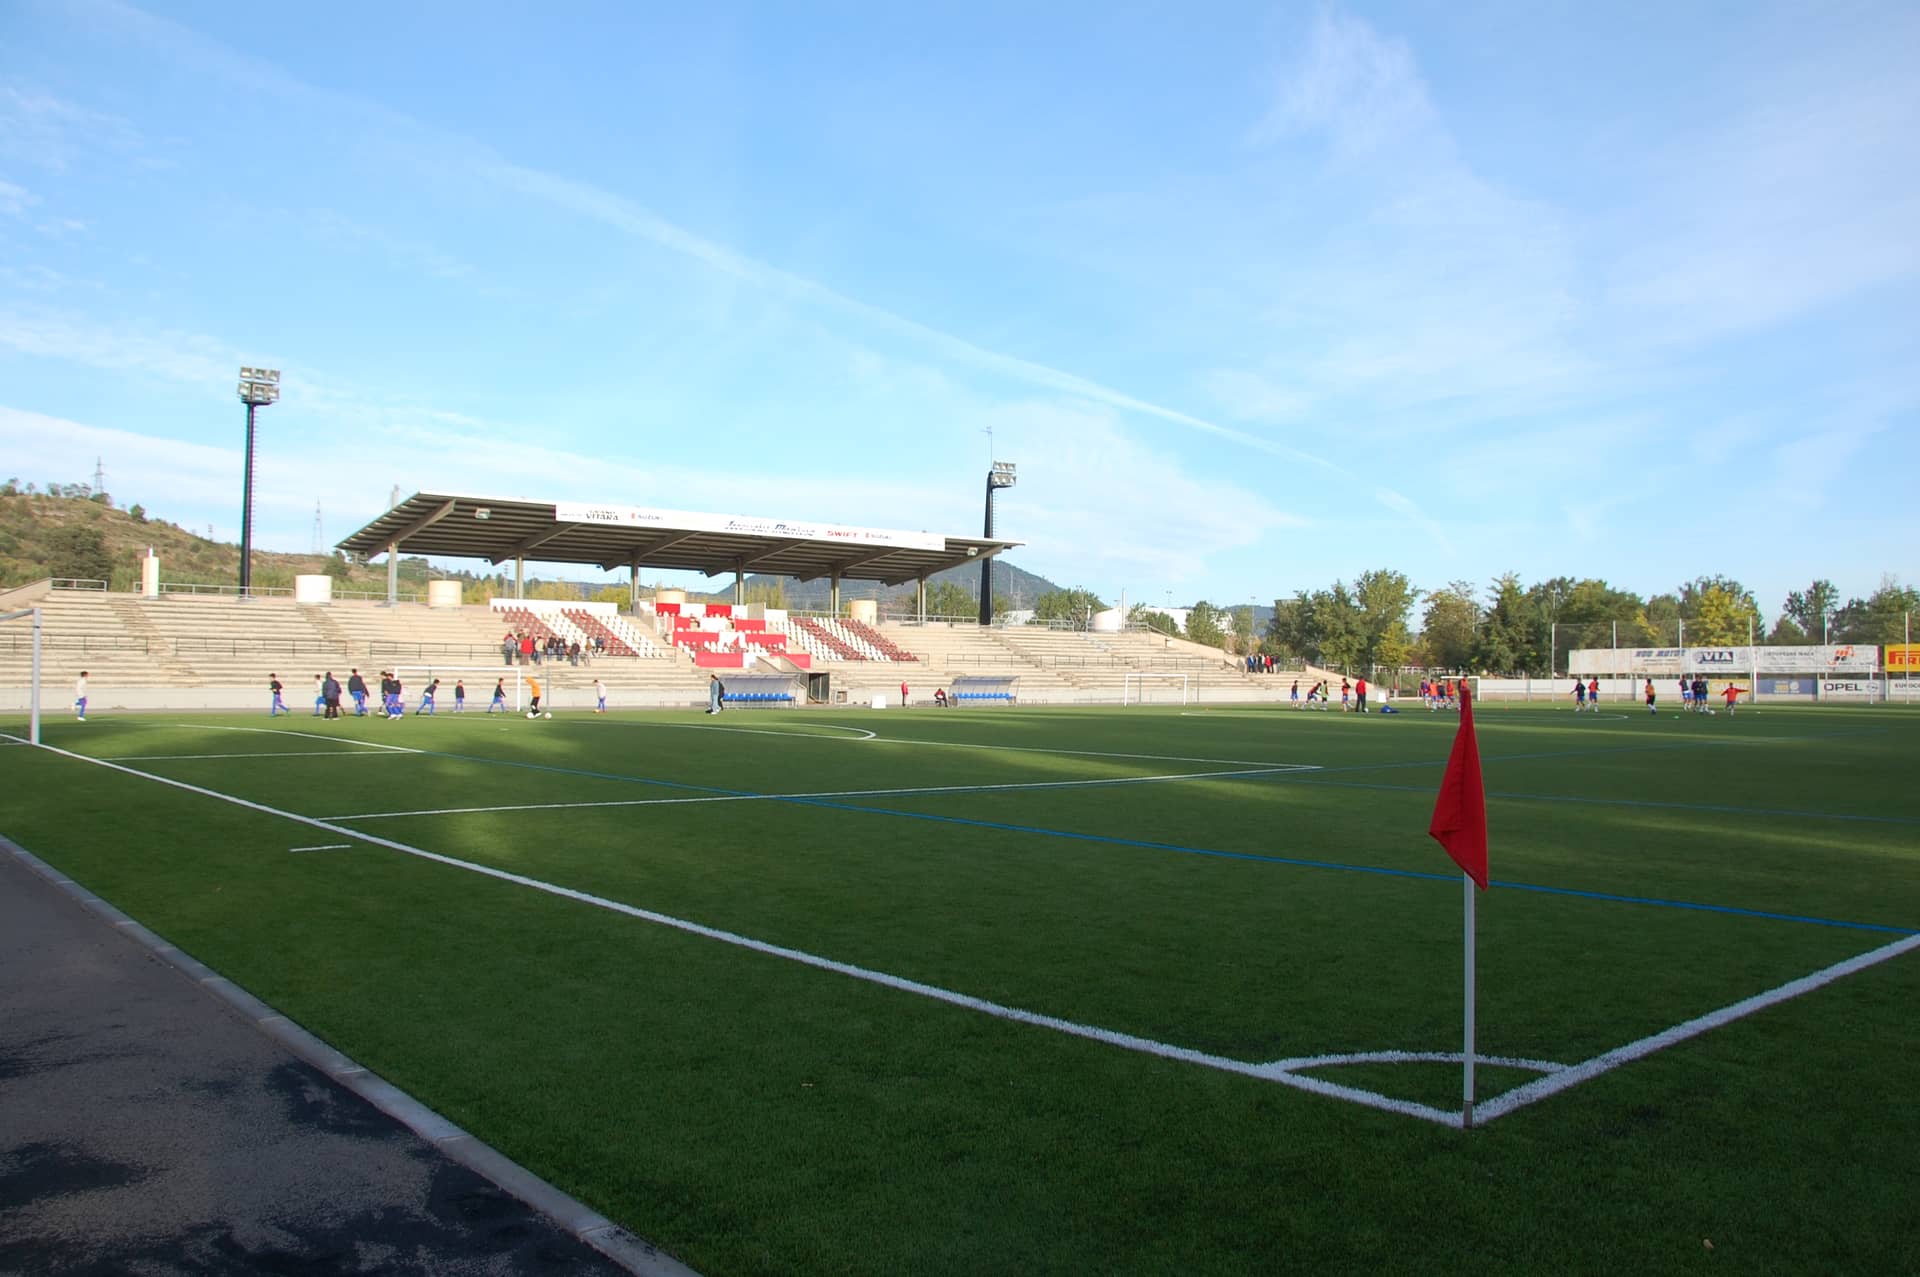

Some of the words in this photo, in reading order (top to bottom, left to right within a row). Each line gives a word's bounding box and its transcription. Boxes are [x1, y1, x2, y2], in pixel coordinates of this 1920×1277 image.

[827, 530, 858, 538] SWIFT
[1888, 650, 1920, 665] PIR
[1824, 682, 1863, 692] OPEL
